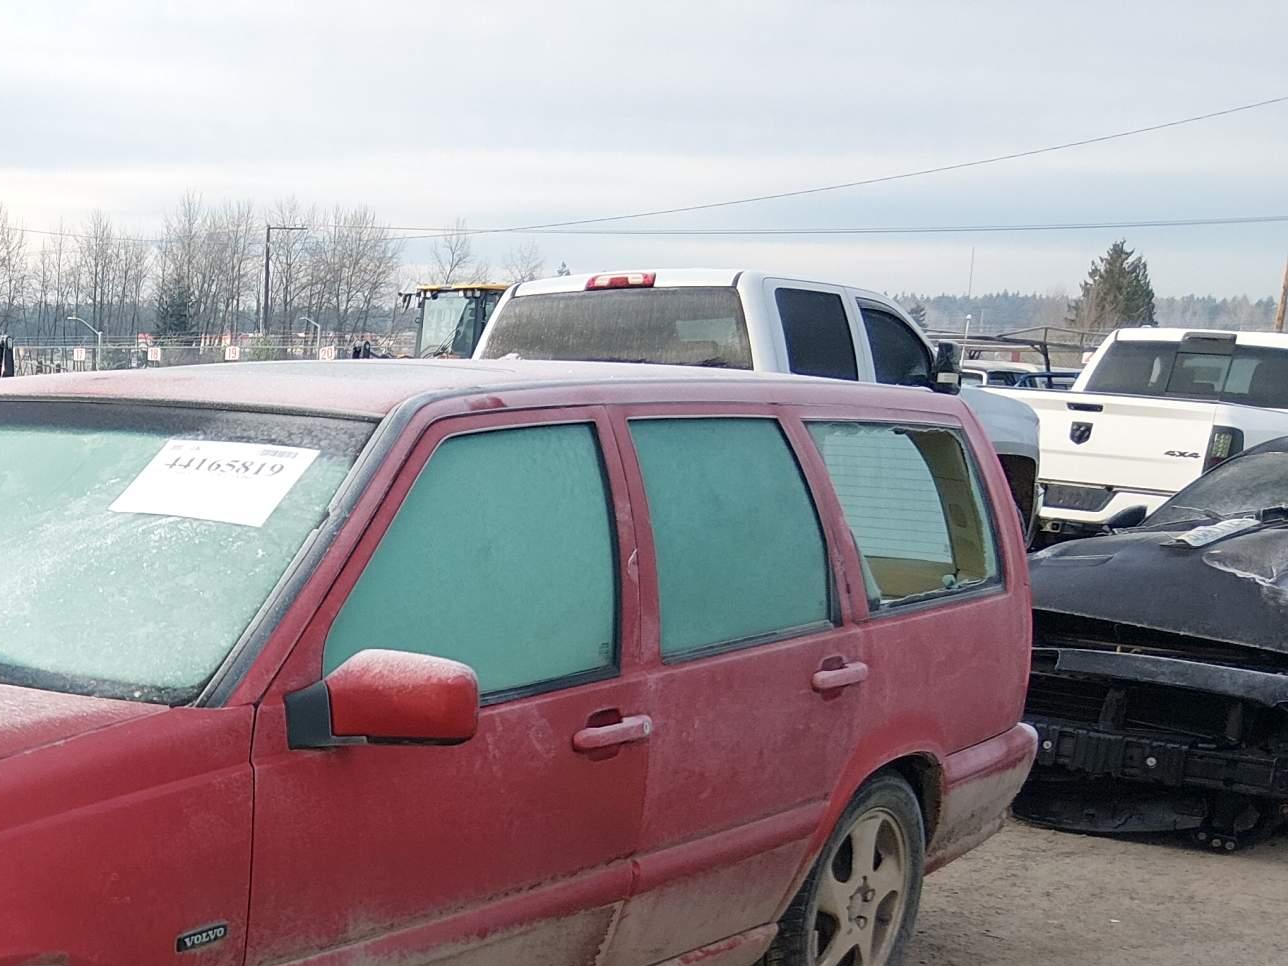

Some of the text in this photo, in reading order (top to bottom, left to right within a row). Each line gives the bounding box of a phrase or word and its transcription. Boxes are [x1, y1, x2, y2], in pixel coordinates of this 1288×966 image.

[320, 347, 333, 360] 20
[165, 456, 284, 476] 44165819
[183, 927, 224, 946] VOLVO
